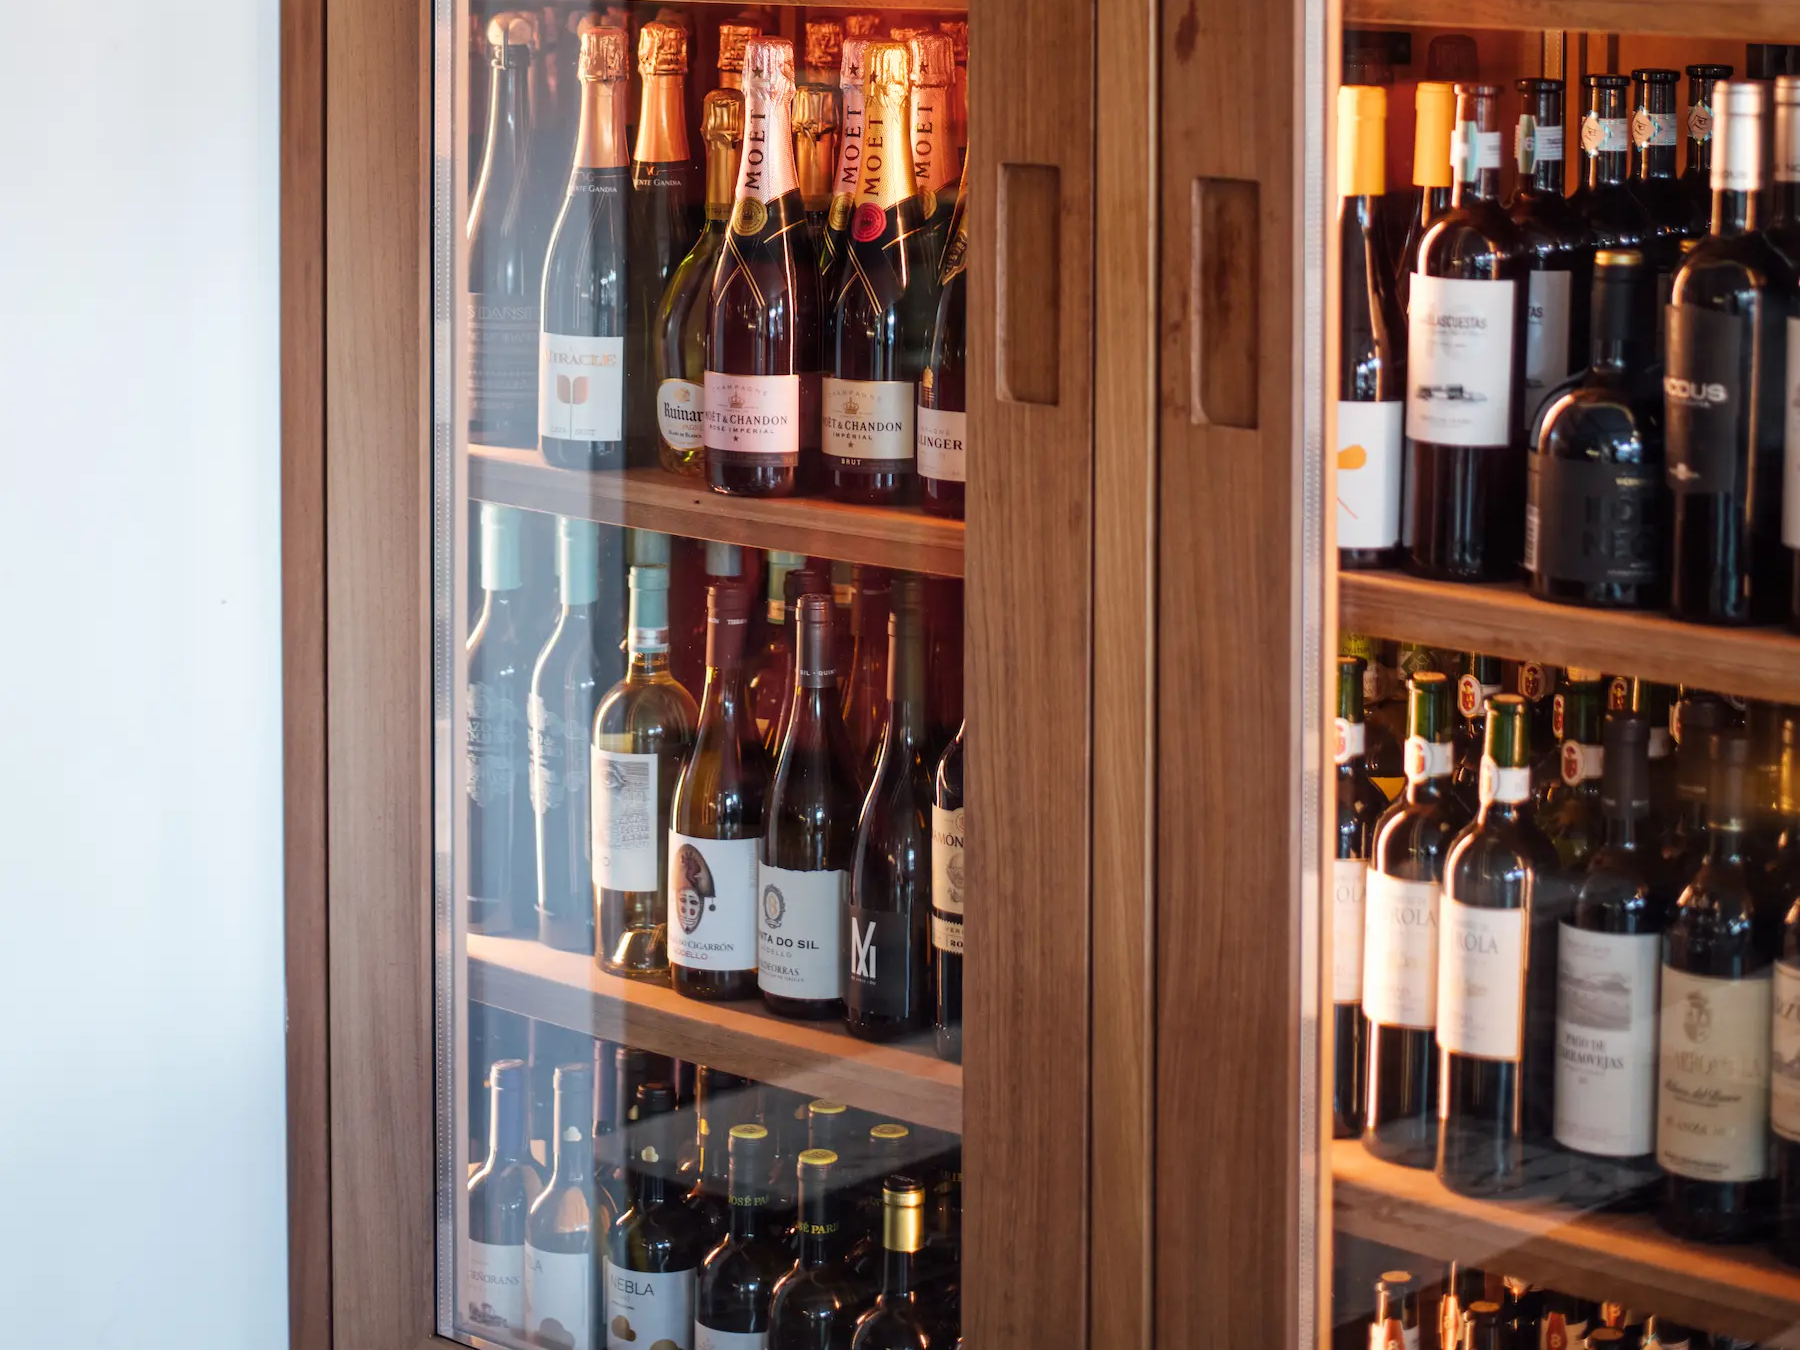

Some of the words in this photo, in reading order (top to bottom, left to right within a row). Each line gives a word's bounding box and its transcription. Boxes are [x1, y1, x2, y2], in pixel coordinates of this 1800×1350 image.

[663, 401, 704, 422] Ruinar
[722, 415, 728, 423] &
[729, 414, 789, 426] CHANDON
[823, 416, 836, 429] OËT
[837, 421, 843, 430] &
[844, 420, 903, 432] CHANDON
[728, 425, 775, 434] IMPÉRIAL
[832, 431, 874, 441] IMPÉRIAL
[840, 457, 862, 466] BRUT
[687, 939, 735, 952] CIGARRÓN
[776, 936, 794, 948] DO
[797, 939, 820, 950] SIL
[609, 1273, 656, 1297] NEBLA
